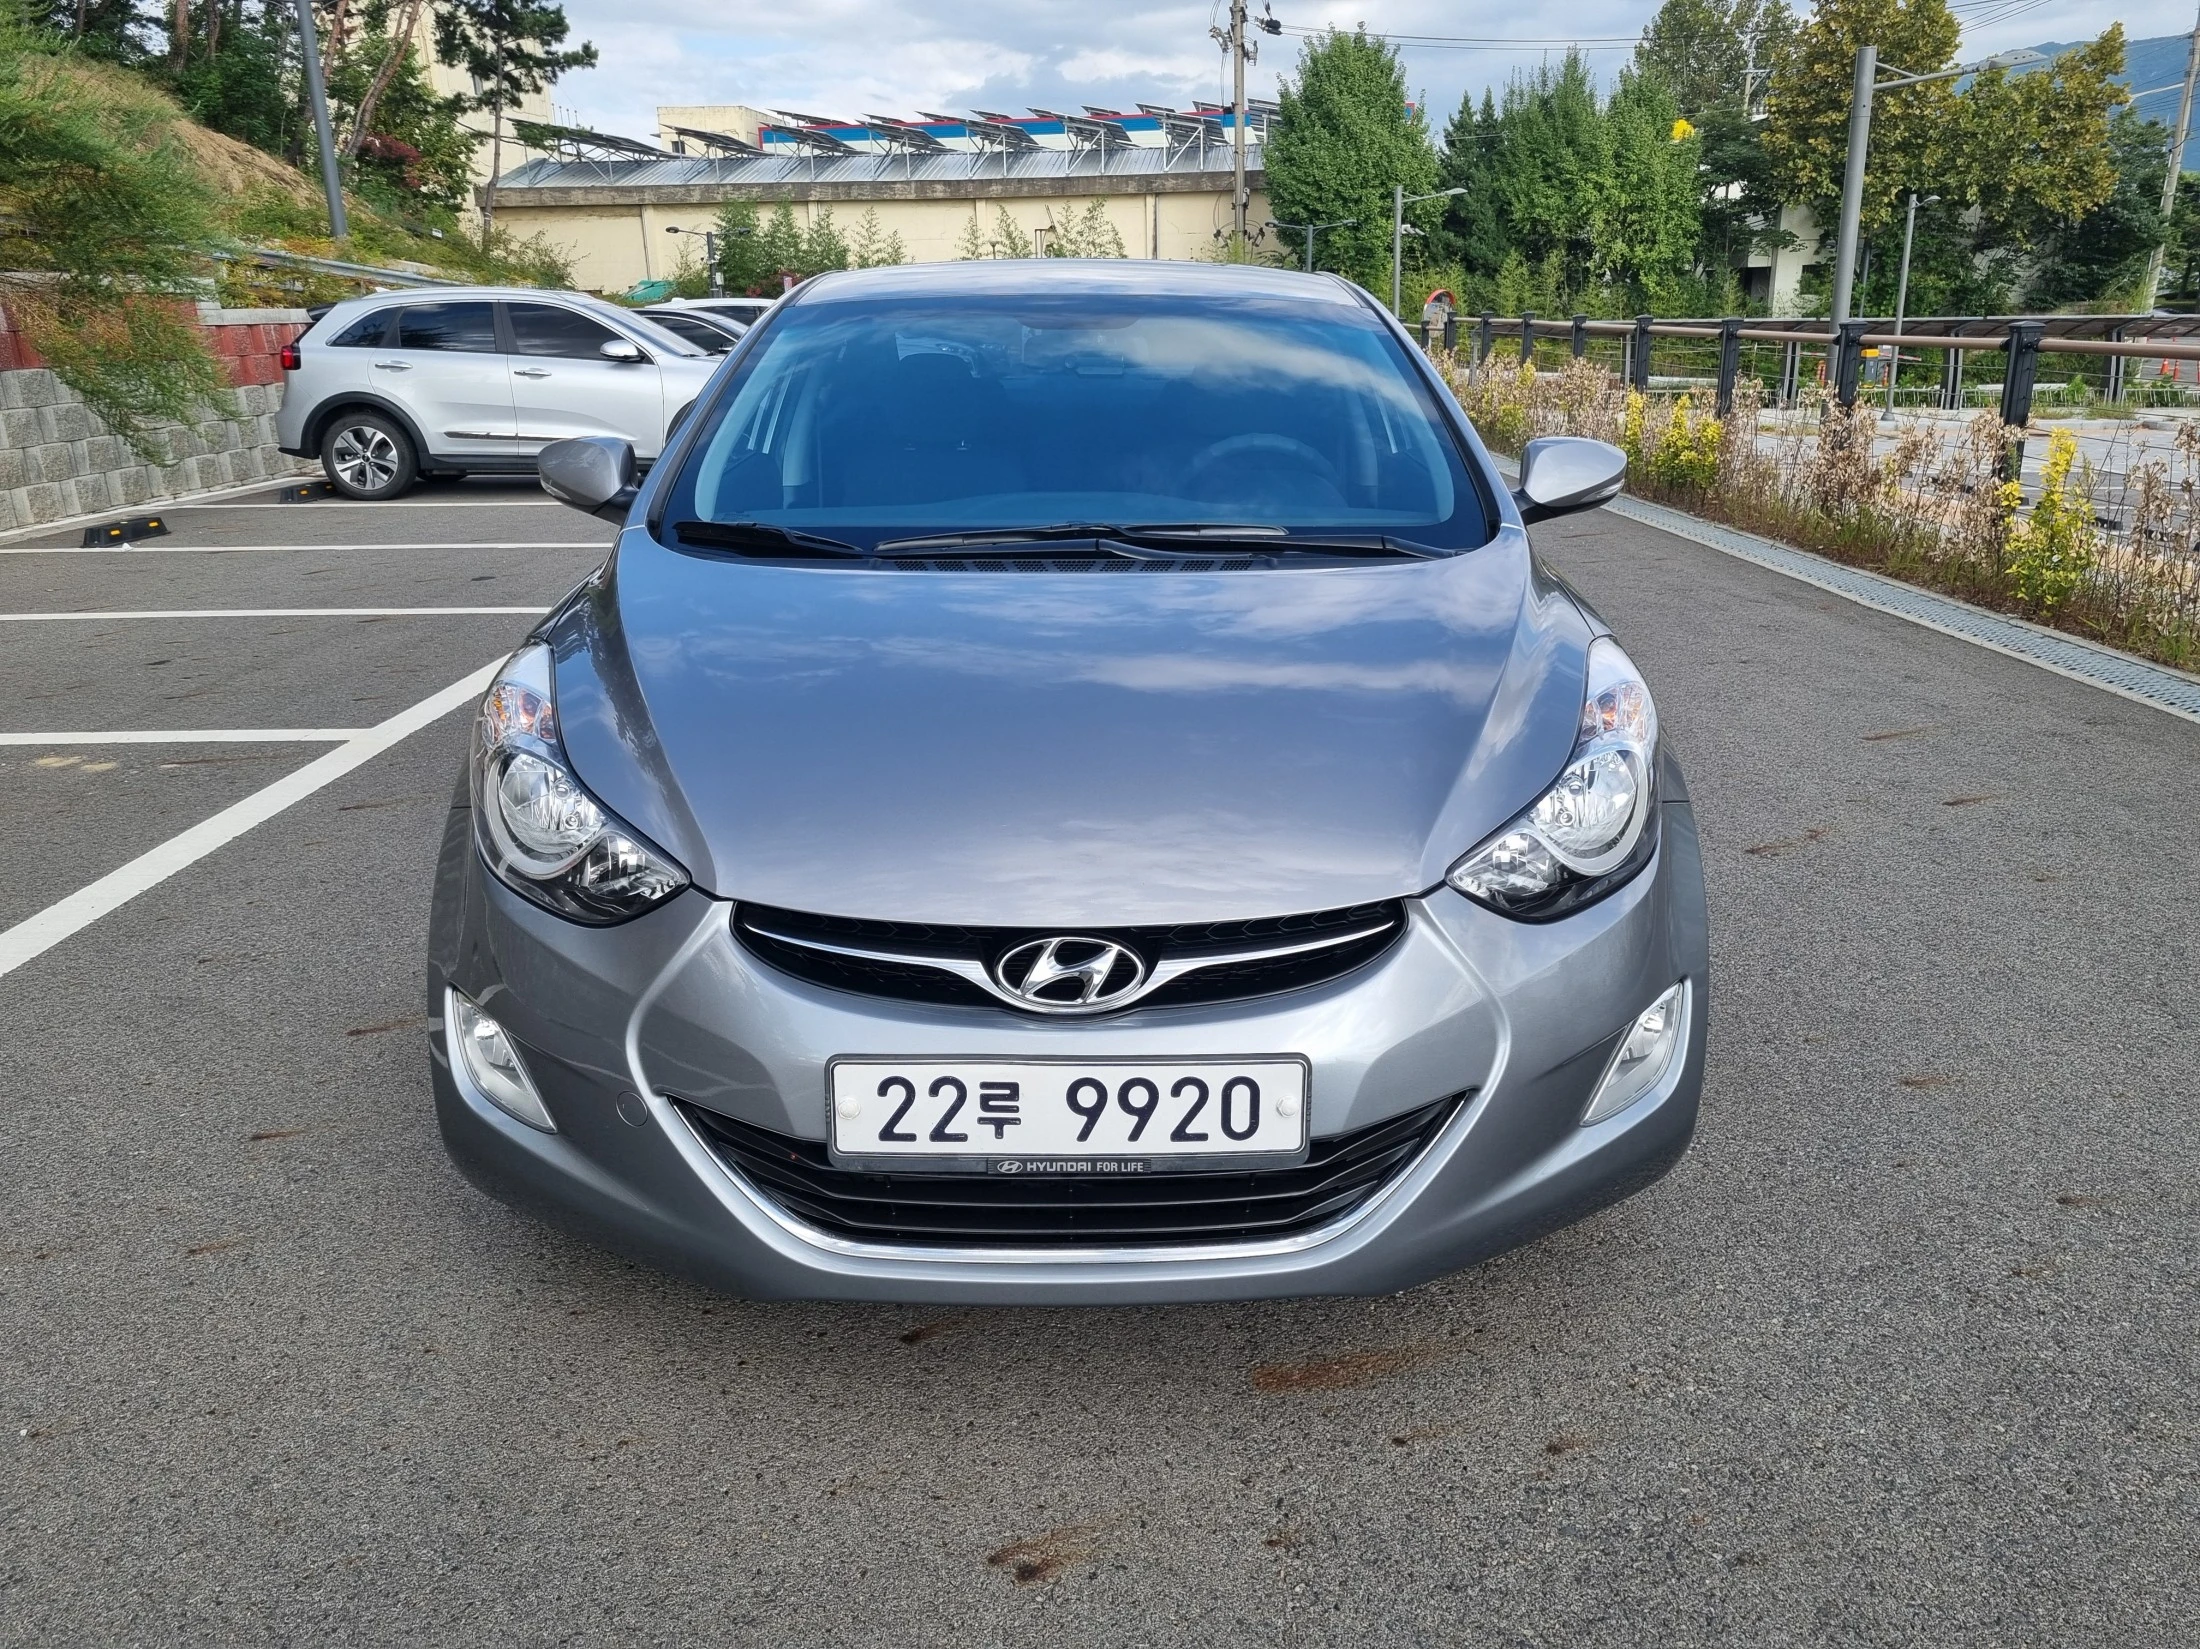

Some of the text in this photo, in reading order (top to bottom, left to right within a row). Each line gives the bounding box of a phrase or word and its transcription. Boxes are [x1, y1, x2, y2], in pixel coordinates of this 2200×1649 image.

[877, 1075, 1261, 1143] 22루 9920
[1026, 1161, 1144, 1172] HYUNDAI FOR LIFE
